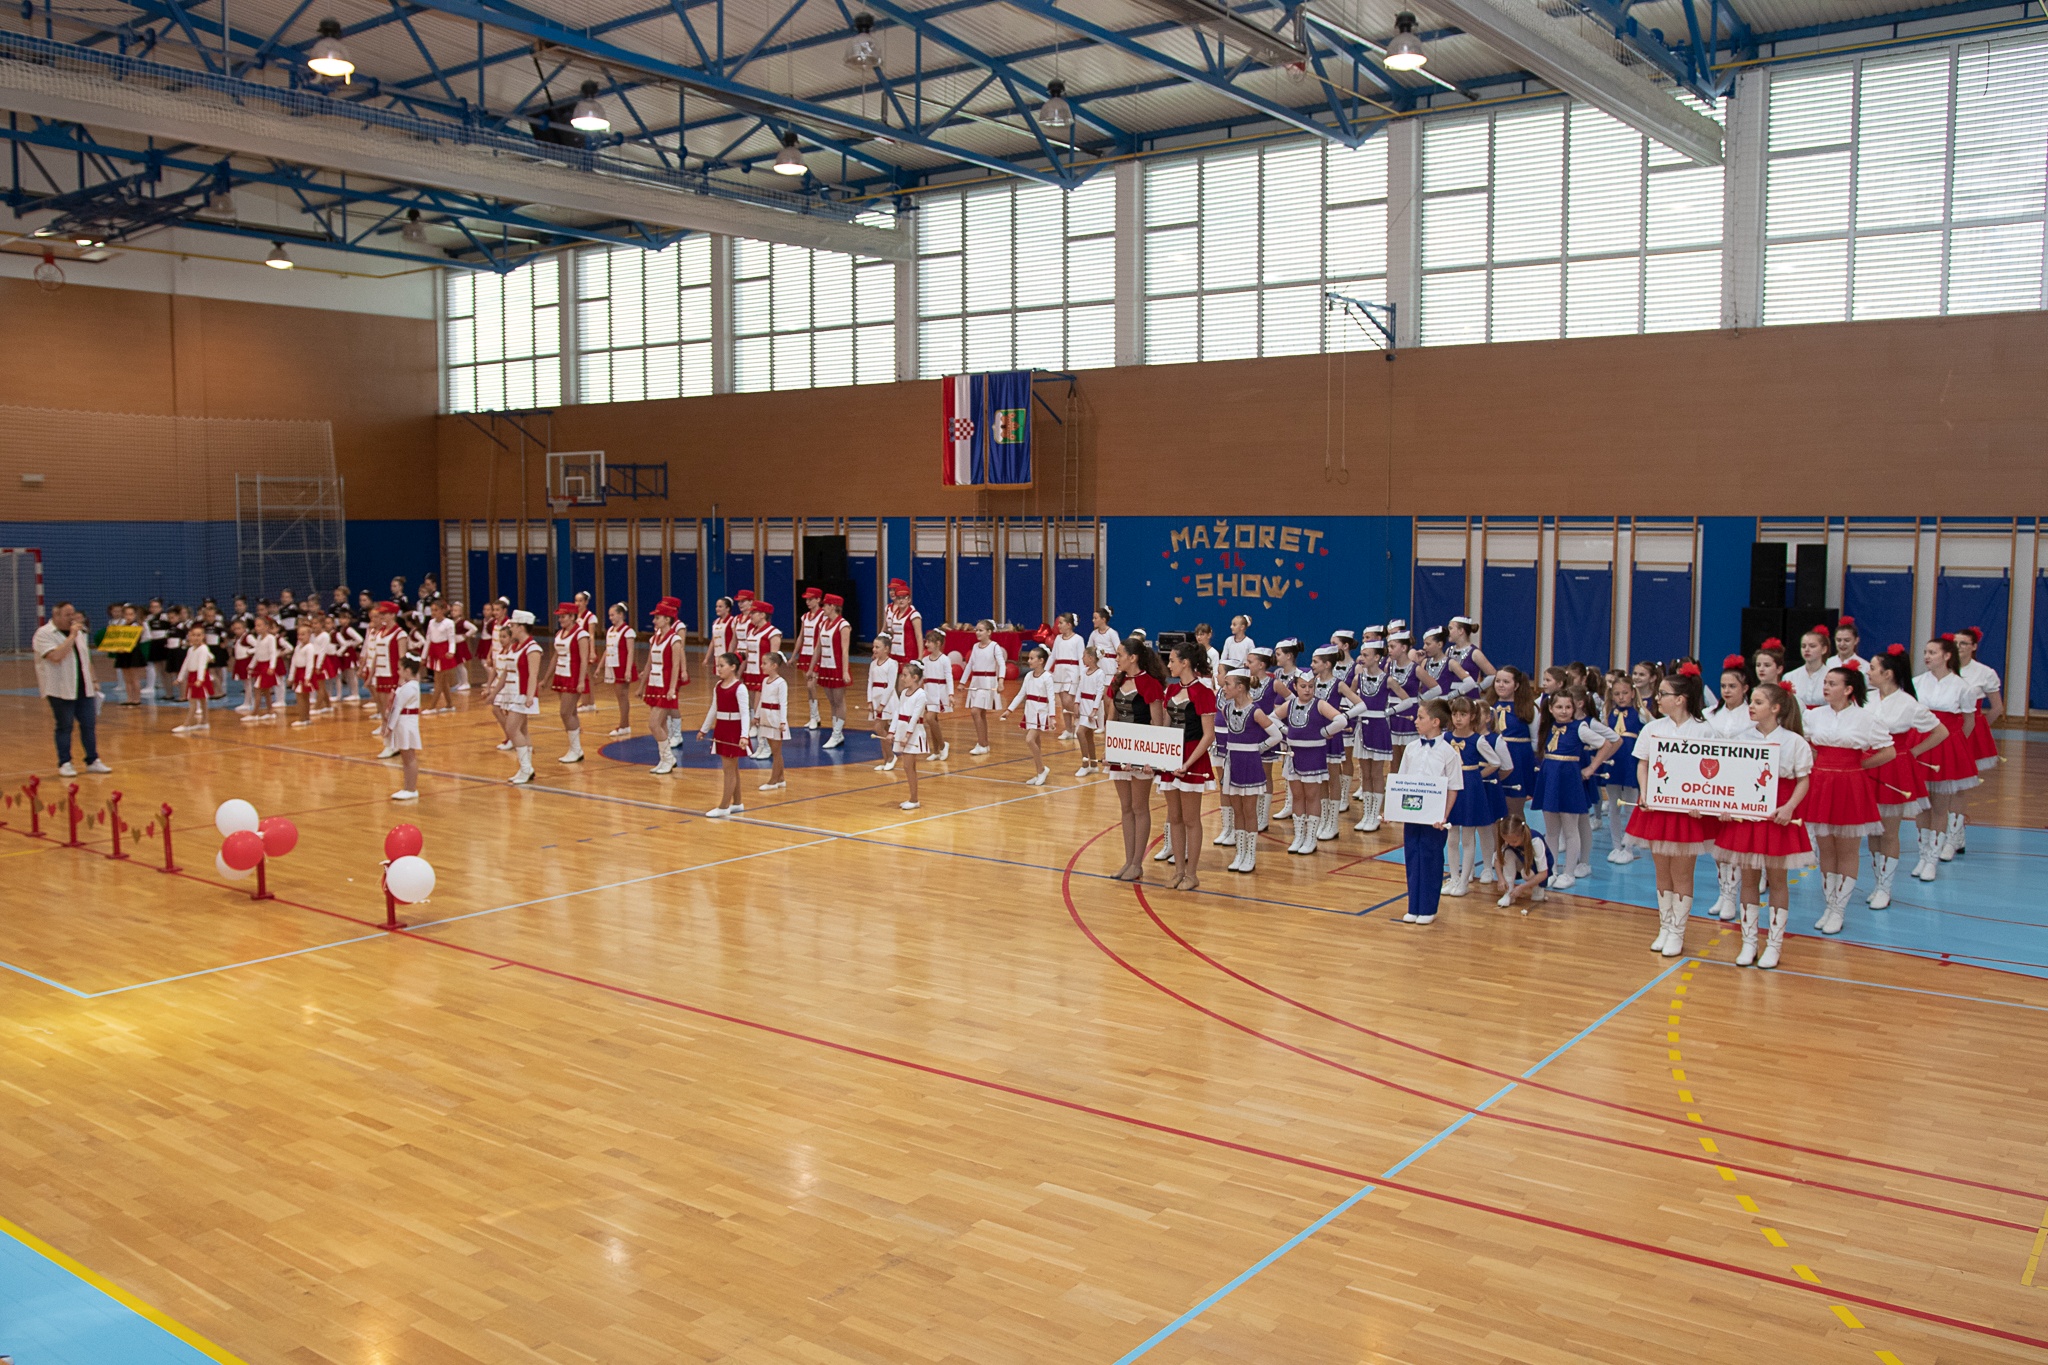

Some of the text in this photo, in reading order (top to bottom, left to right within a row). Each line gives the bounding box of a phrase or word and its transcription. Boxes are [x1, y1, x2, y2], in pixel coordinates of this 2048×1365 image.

[1170, 519, 1324, 554] MAŽORET
[1219, 552, 1246, 570] 14
[1195, 573, 1290, 599] SHOW
[1107, 736, 1182, 757] DONJI KRALJEVEC
[1657, 740, 1770, 760] MAŽORETKINJE
[1653, 795, 1768, 813] SVETI MARTIN NA MURI
